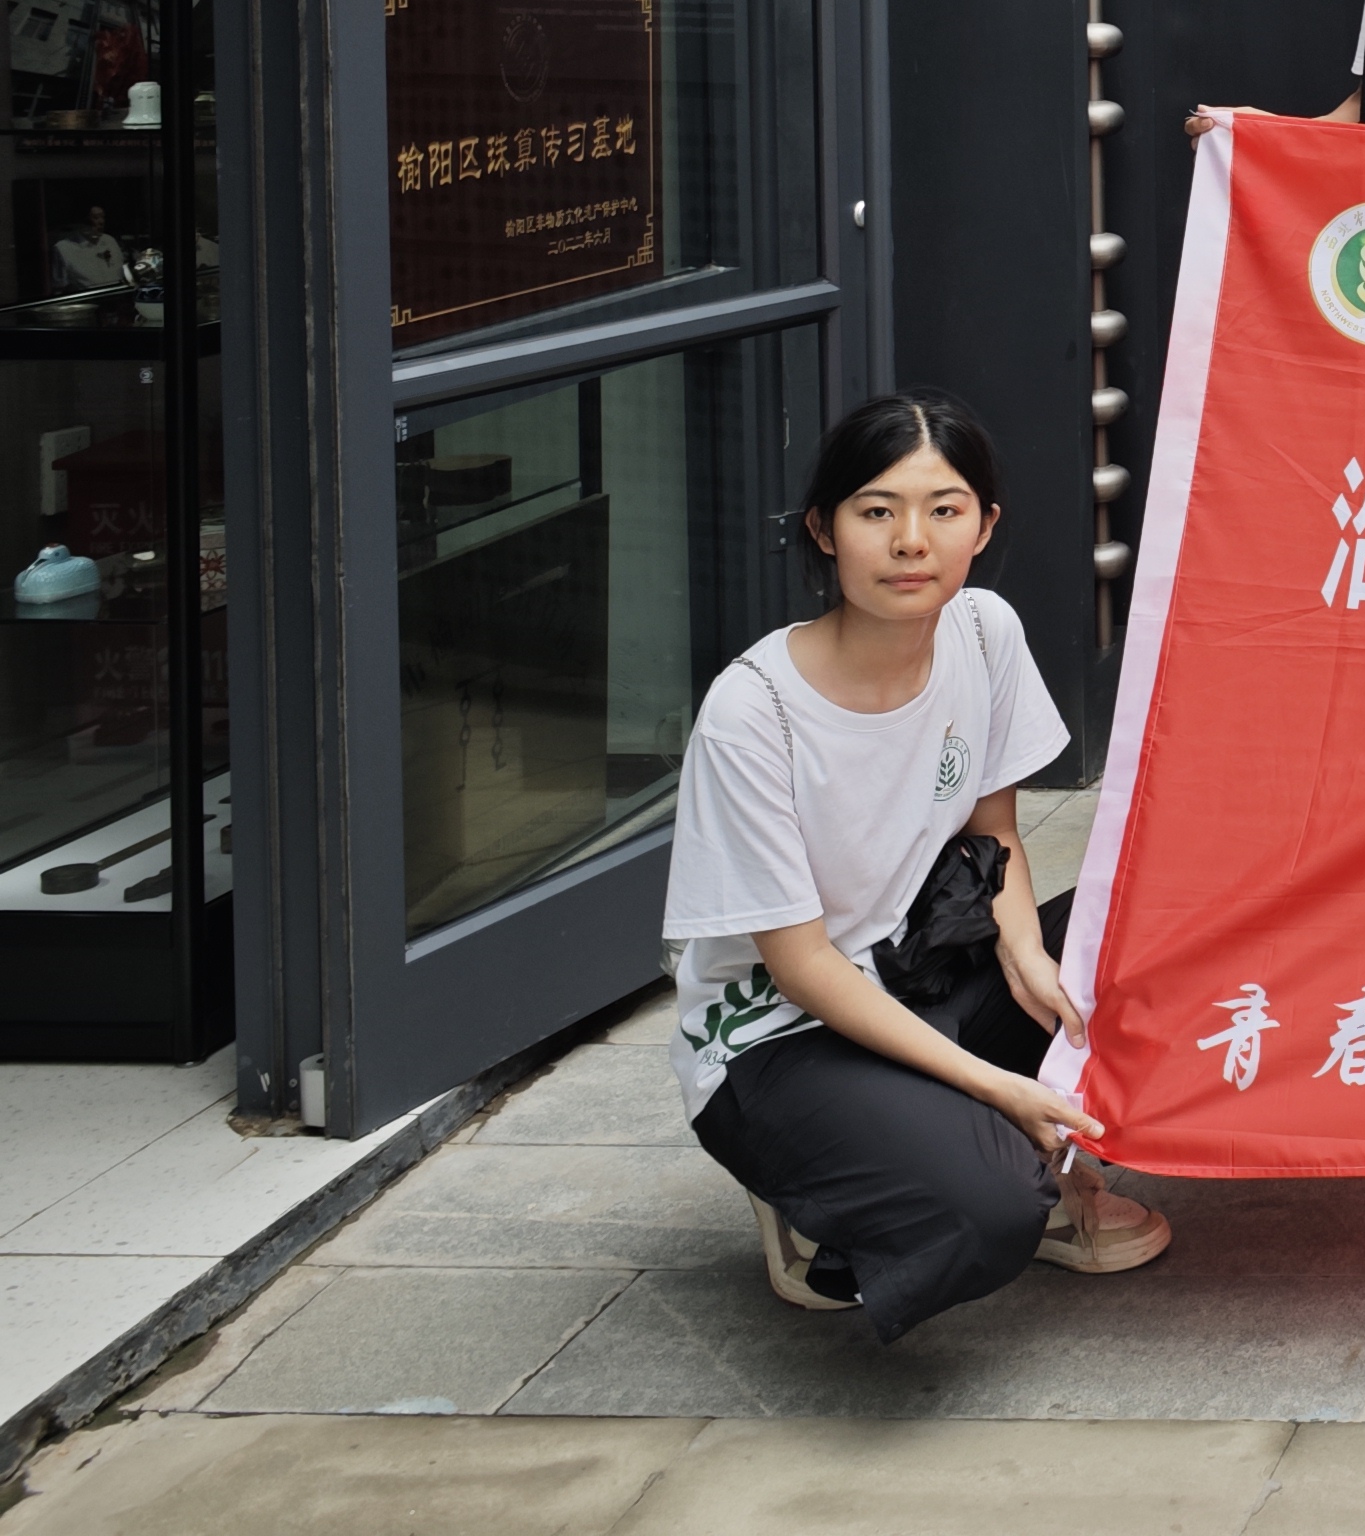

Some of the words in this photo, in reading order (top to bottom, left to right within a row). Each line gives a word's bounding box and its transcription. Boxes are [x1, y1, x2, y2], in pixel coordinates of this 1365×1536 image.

[396, 112, 637, 195] 榆阳区珠算传习基地
[700, 1048, 728, 1066] 1934
